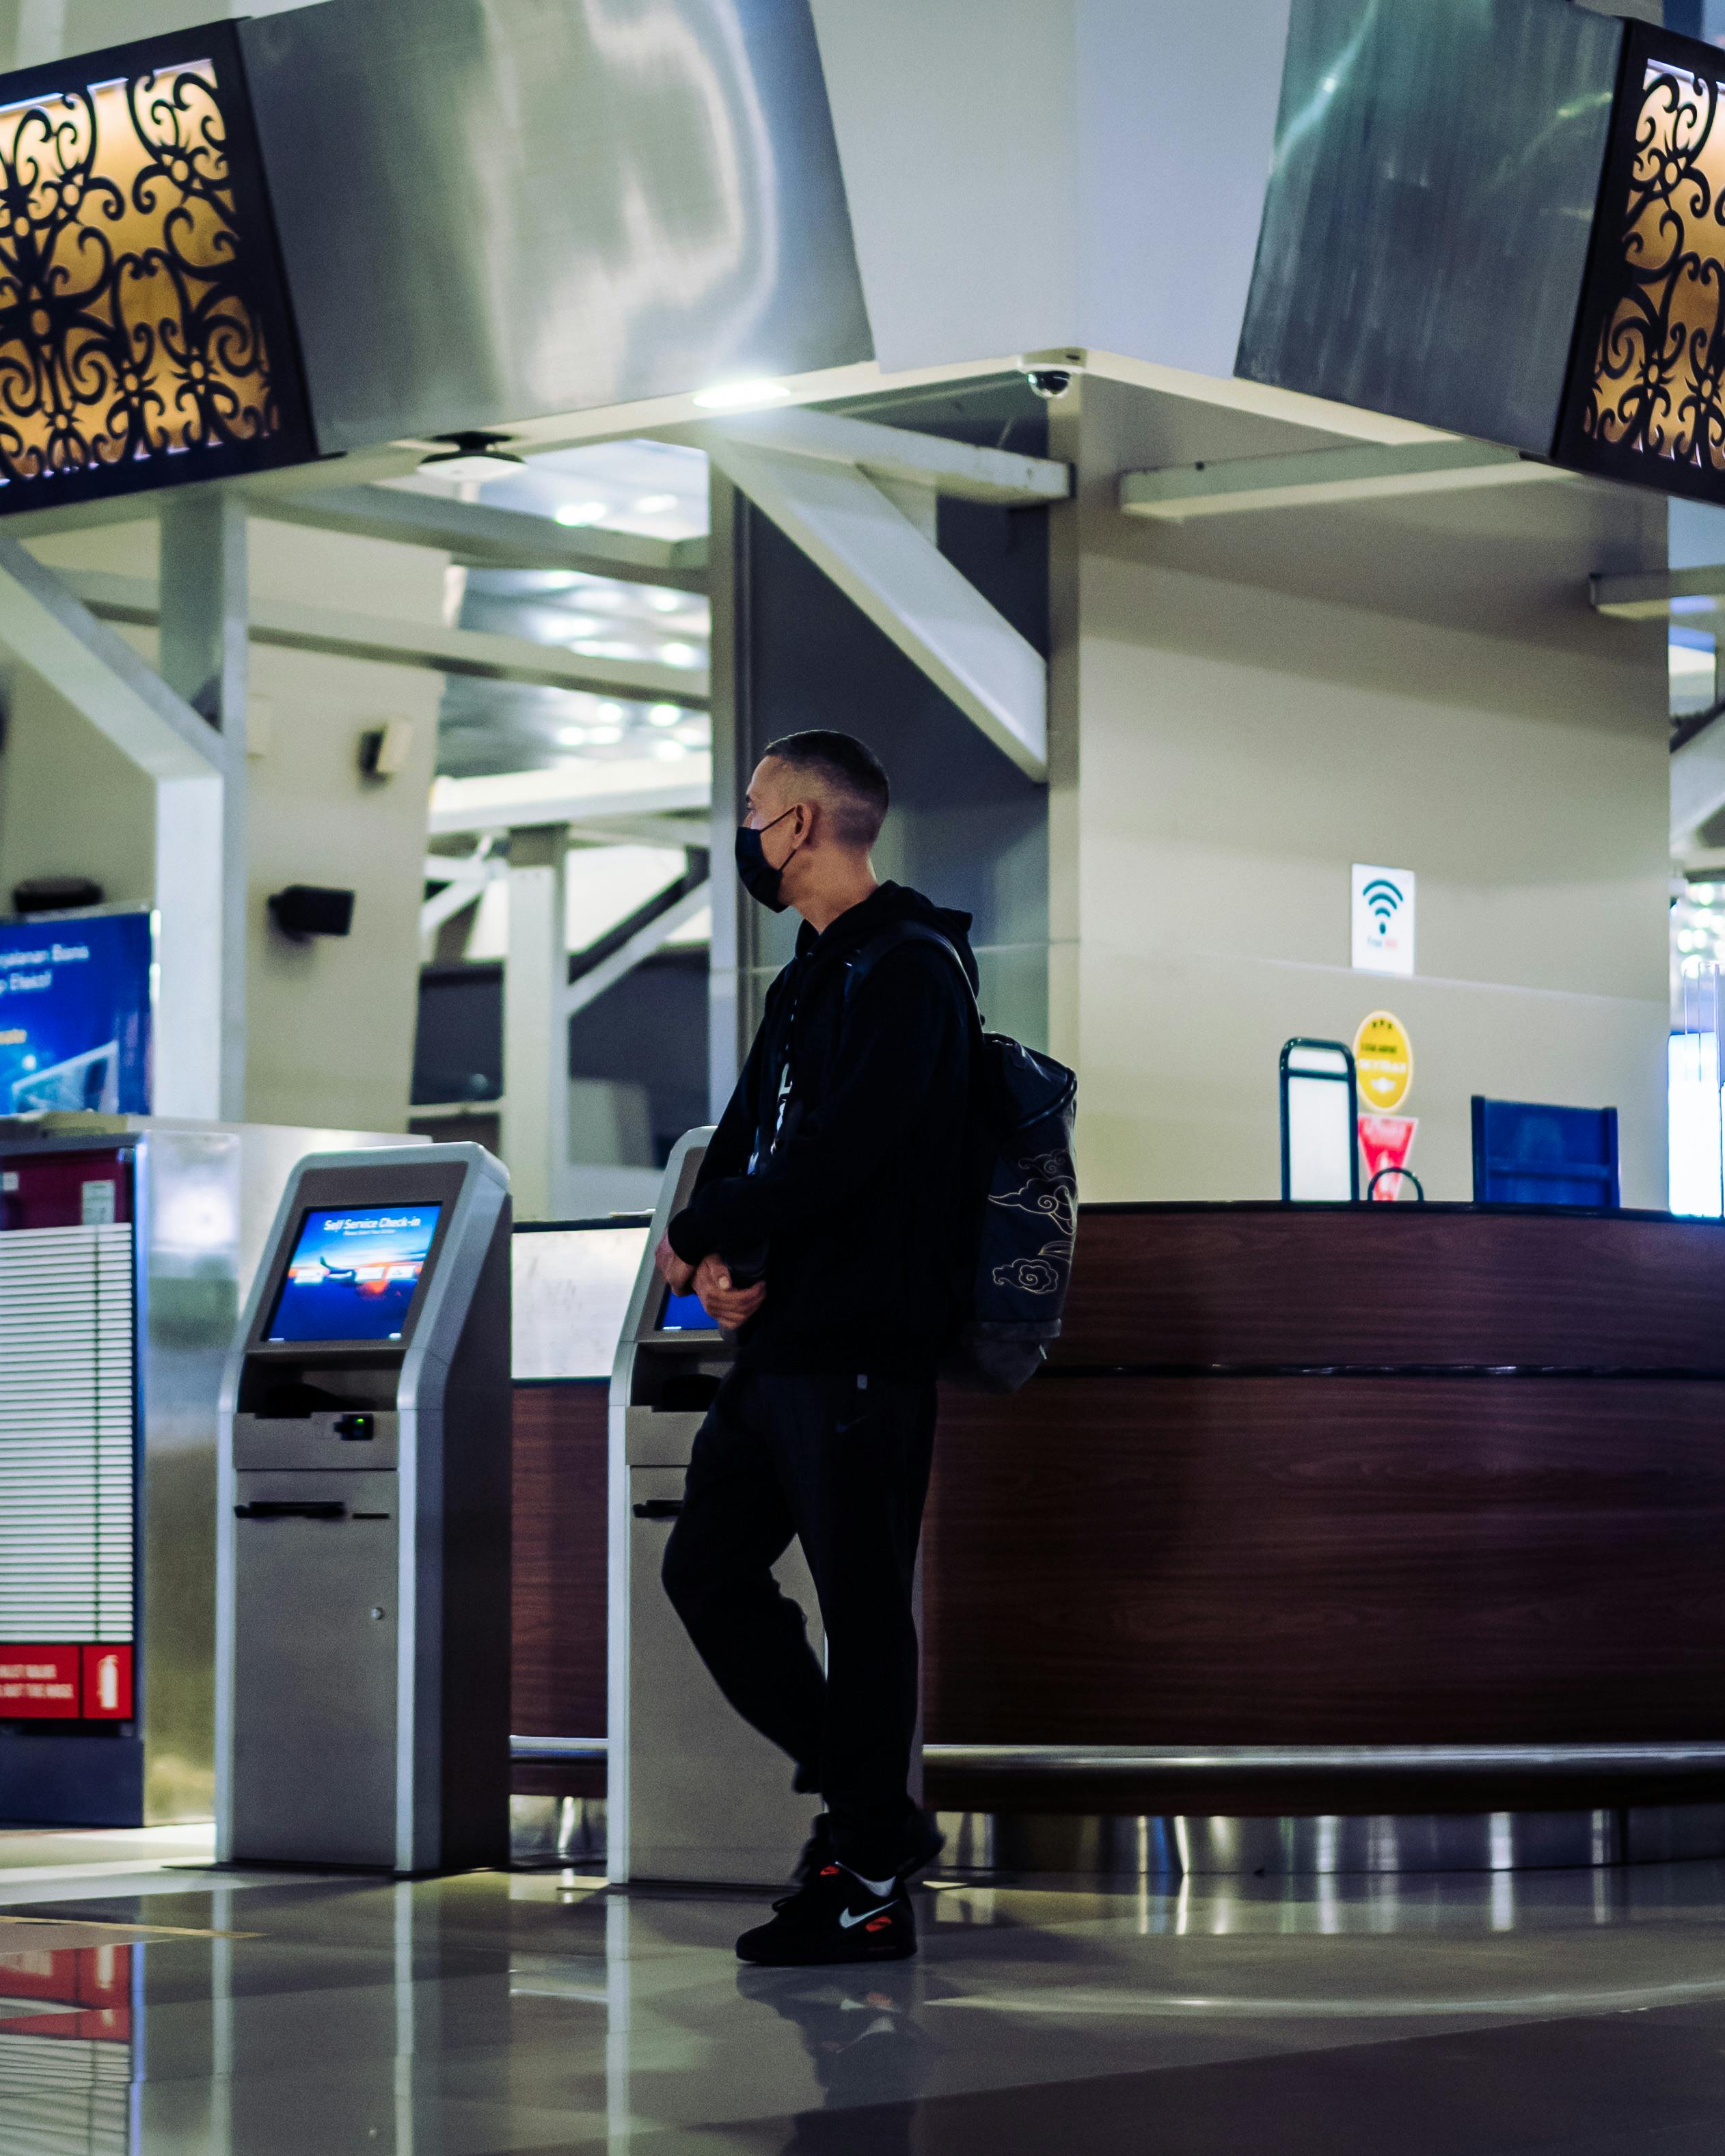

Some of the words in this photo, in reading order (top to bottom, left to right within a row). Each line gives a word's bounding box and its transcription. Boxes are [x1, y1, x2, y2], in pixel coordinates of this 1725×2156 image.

[323, 1220, 344, 1231] Self
[344, 1218, 378, 1229] Service
[380, 1216, 420, 1227] Check-in
